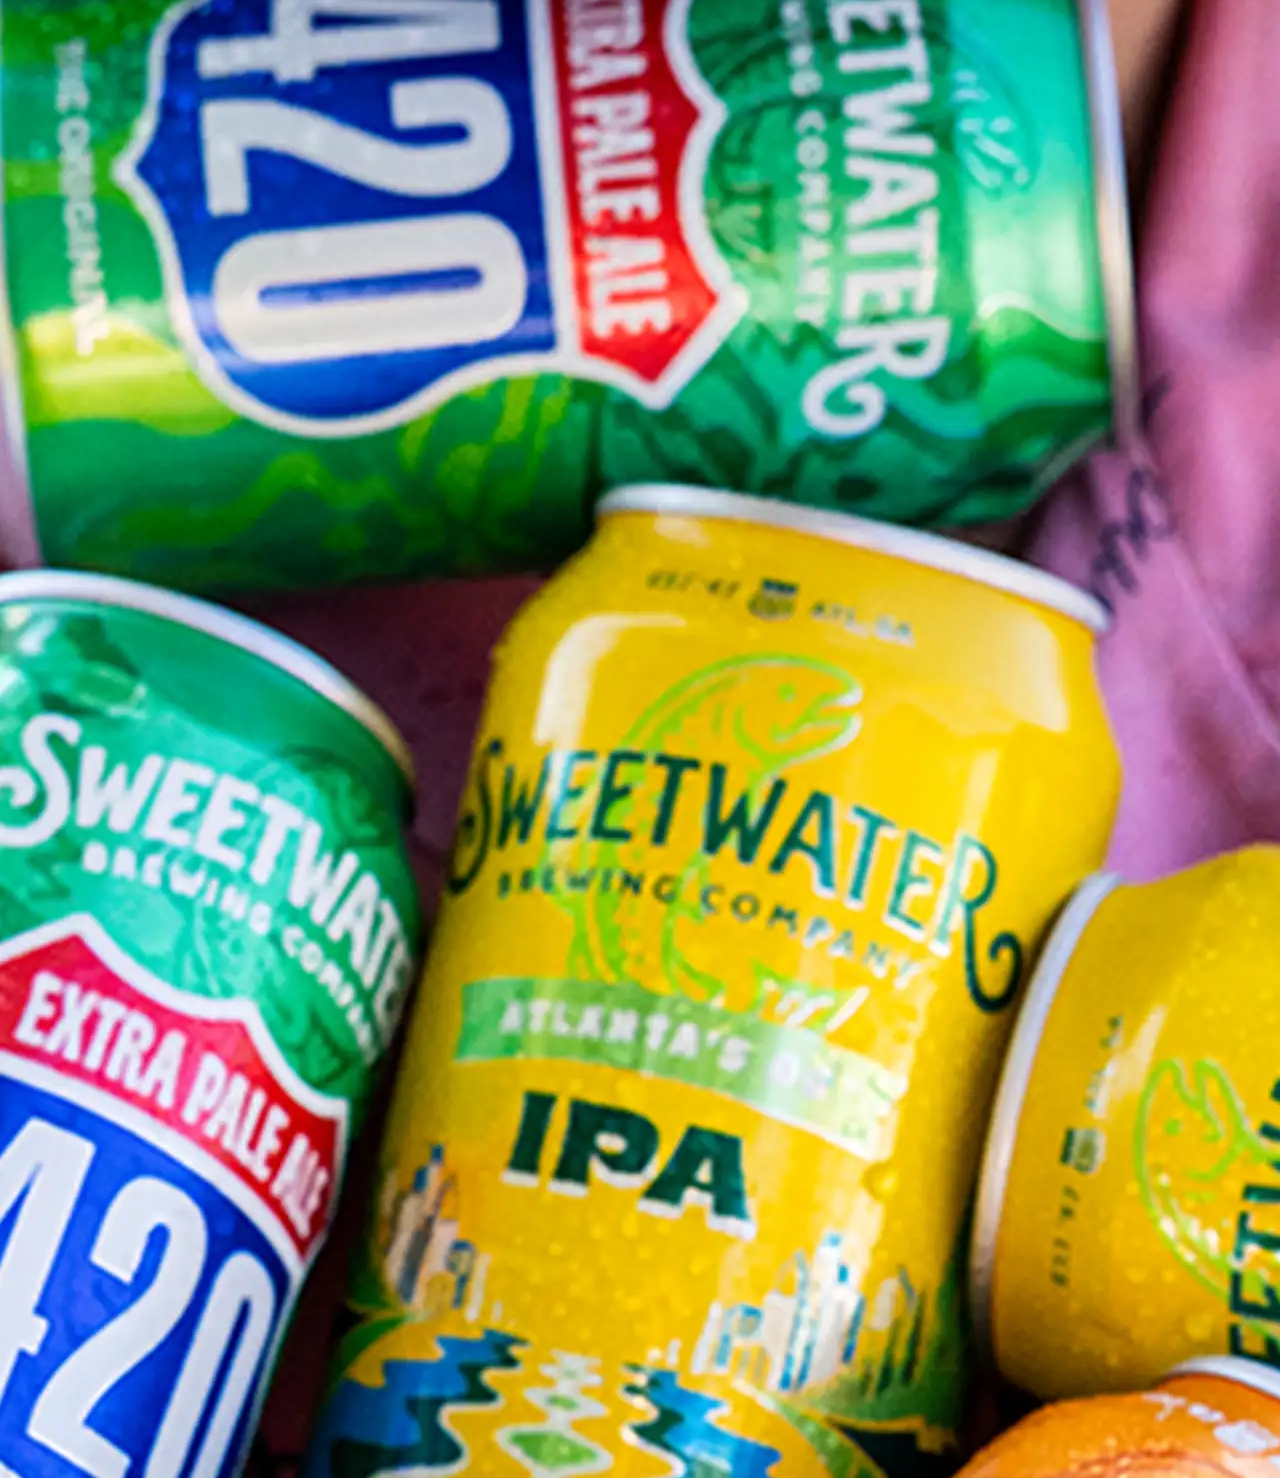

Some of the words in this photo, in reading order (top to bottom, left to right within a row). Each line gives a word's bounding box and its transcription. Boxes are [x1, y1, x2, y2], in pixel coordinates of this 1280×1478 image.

[570, 94, 662, 224] PALE
[794, 109, 834, 328] COMPANY
[56, 118, 112, 357] ORIGINAL
[582, 224, 674, 341] ALE
[81, 841, 272, 936] BREWING
[444, 738, 1021, 1015] SWEETWATER
[495, 861, 685, 906] BREWING
[697, 878, 926, 991] COMPANY
[12, 967, 190, 1117] EXTRA
[183, 1041, 291, 1186] PALE
[498, 994, 752, 1074] ATLANTA'S
[499, 1088, 758, 1241] IPA
